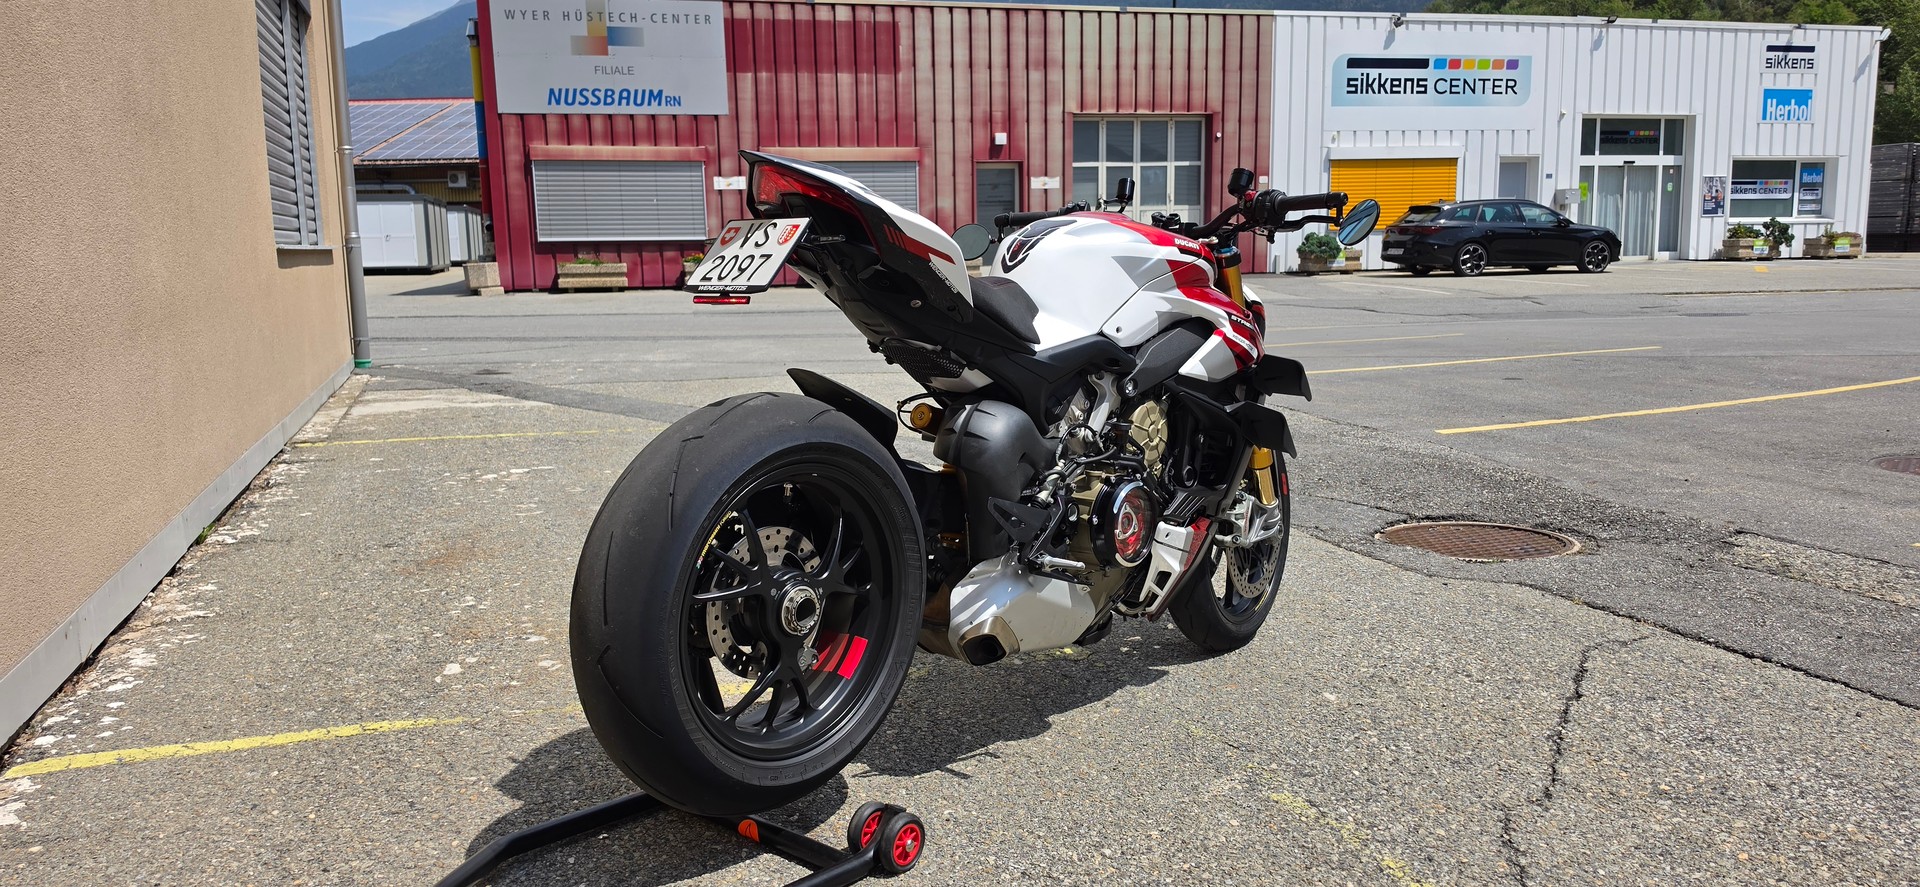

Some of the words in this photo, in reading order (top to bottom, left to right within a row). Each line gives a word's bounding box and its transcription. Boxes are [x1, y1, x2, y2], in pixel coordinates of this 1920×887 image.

[504, 9, 550, 21] WYER
[562, 9, 712, 25] HÜSTECH-CENTER
[1765, 55, 1814, 69] sikkens
[594, 65, 635, 76] FILIALE
[1346, 73, 1428, 95] sikkens
[1433, 78, 1518, 95] CENTER
[1766, 98, 1812, 121] Herbol
[1802, 173, 1823, 183] Herbol
[739, 222, 778, 250] VS
[1174, 237, 1200, 250] DUCATI
[699, 254, 774, 283] 2097
